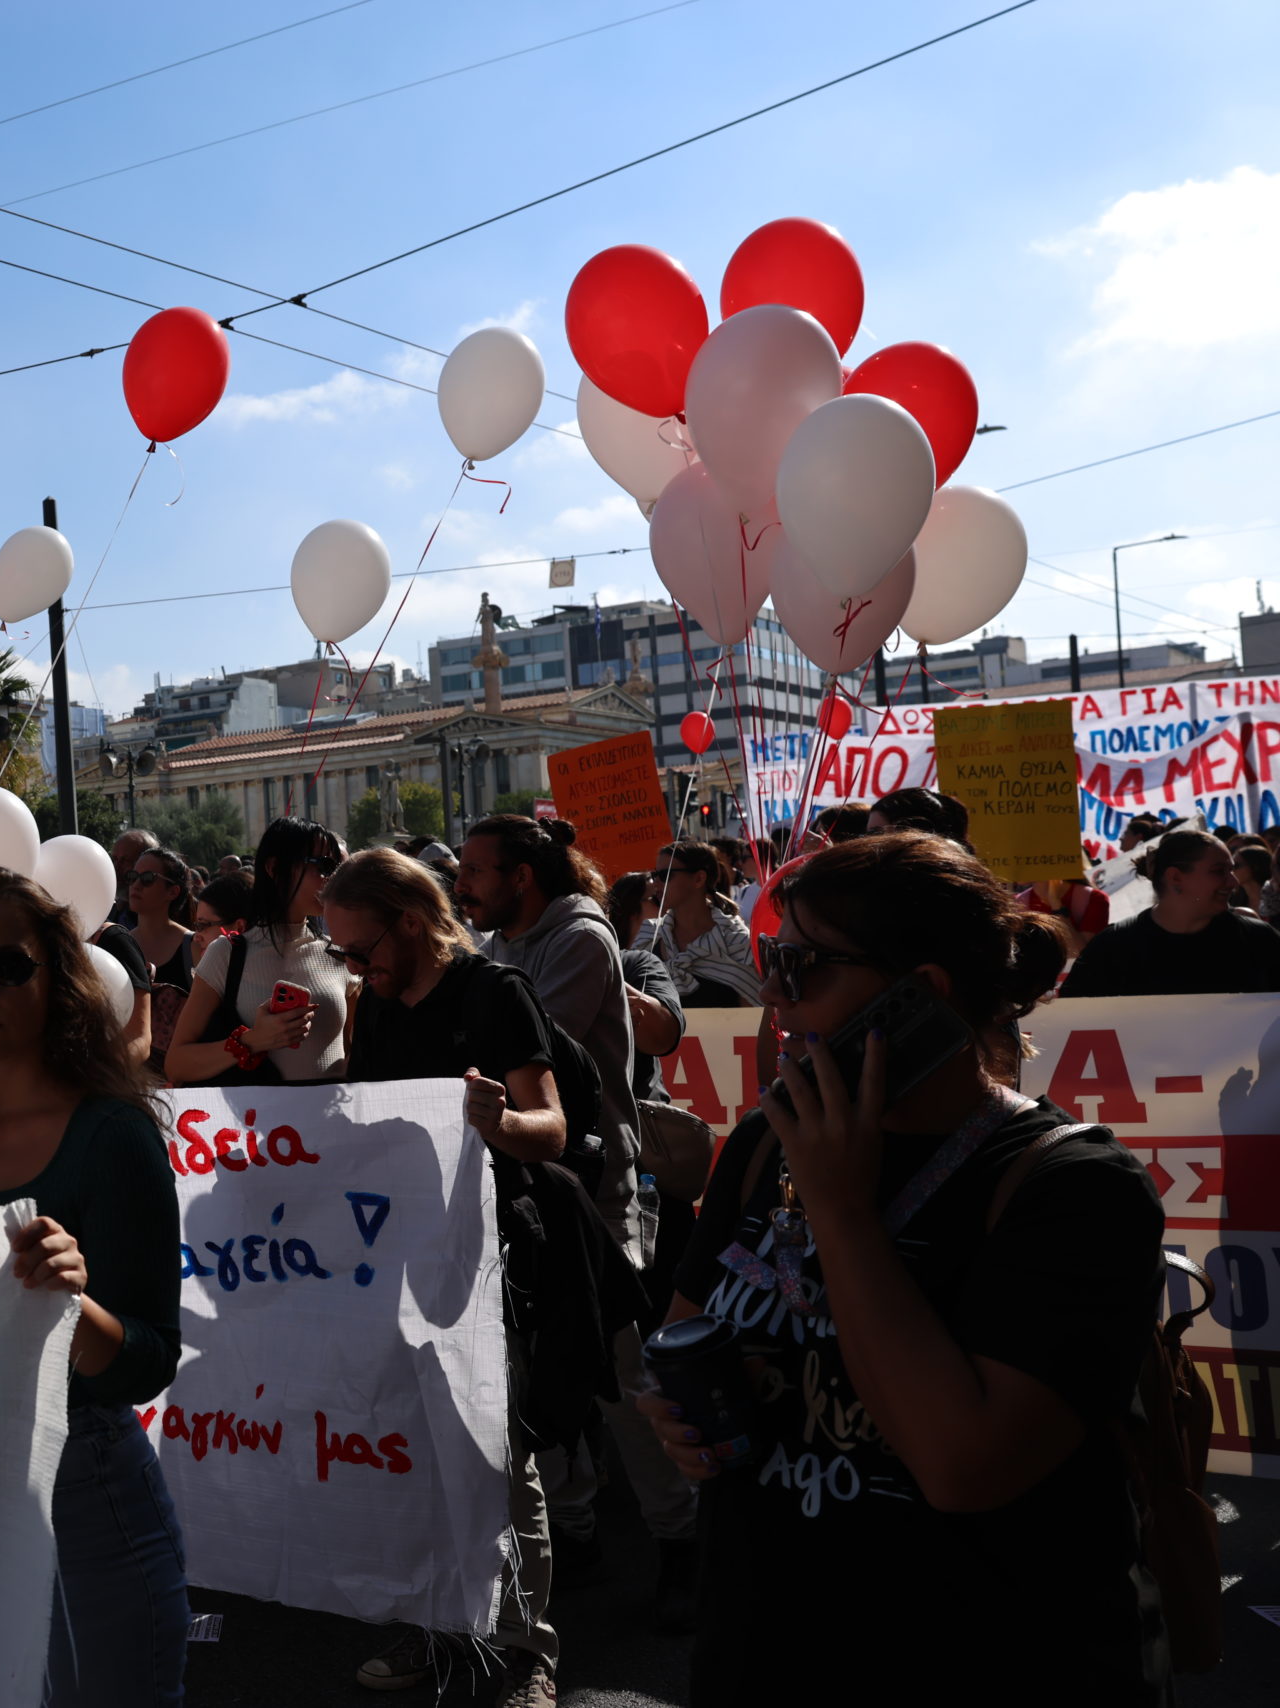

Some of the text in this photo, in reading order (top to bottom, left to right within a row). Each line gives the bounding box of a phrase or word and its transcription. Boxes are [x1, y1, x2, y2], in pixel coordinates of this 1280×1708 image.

[1120, 687, 1183, 715] ΓΙΑ
[1208, 680, 1280, 708] ΤΗΝ
[813, 743, 908, 799] ΑΠΟ
[956, 763, 1006, 780] ΚΑΜΙΑ
[1020, 760, 1067, 778] ΘΥΣΙΑ
[999, 779, 1073, 798] ΠΟΛΕΜΟ
[984, 799, 1037, 815] ΚΕΡΔΗ
[315, 1410, 412, 1482] μας
